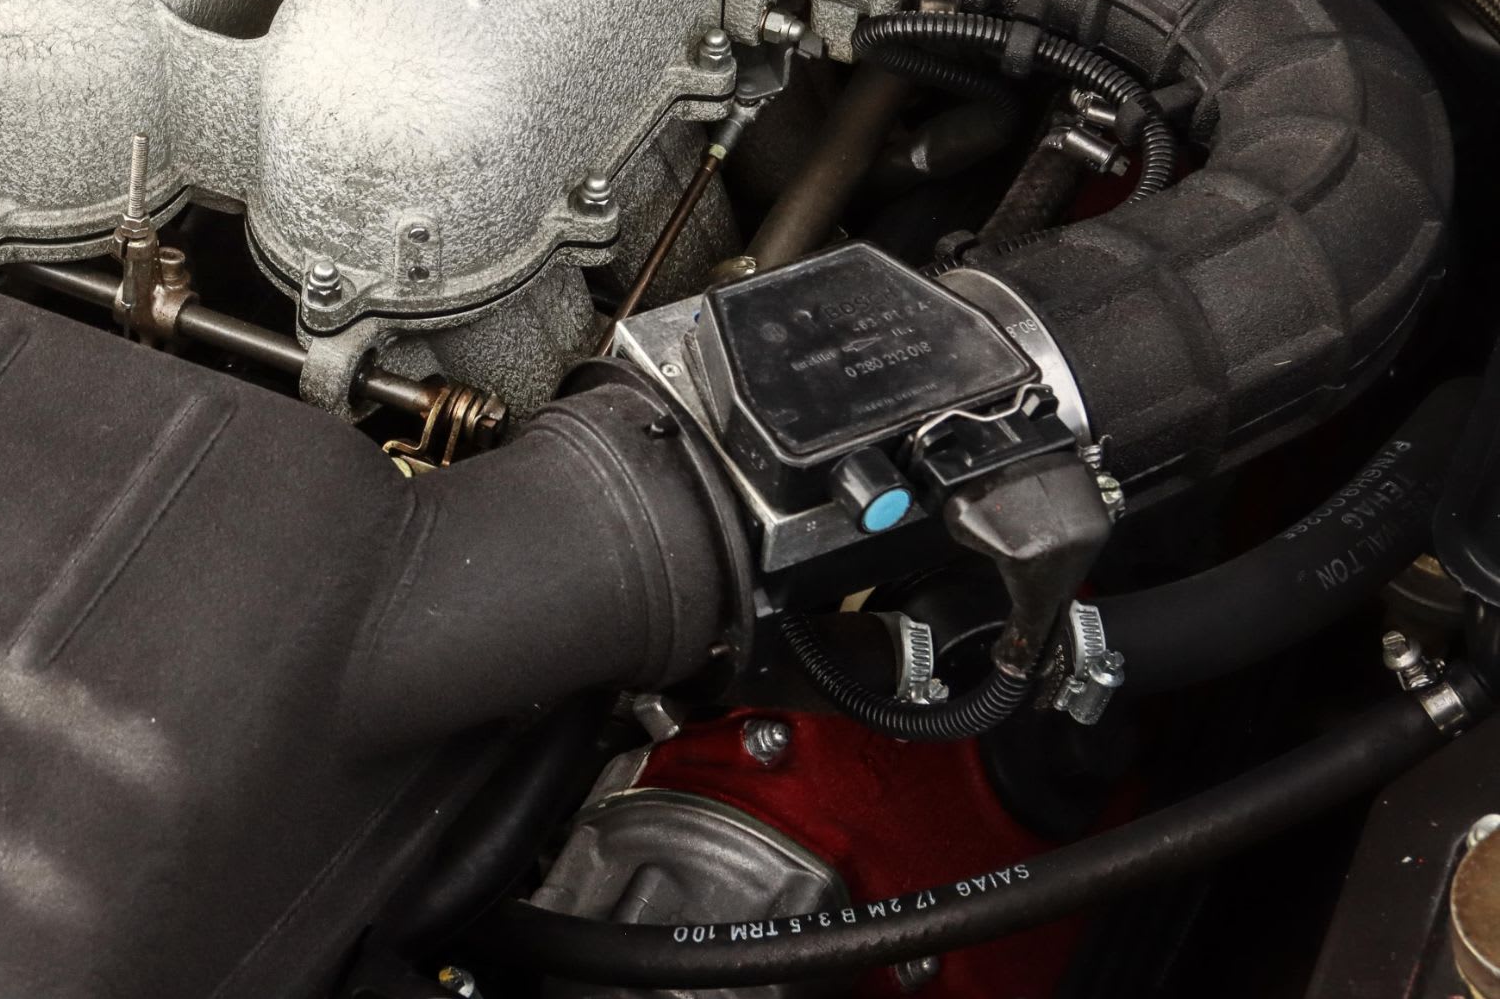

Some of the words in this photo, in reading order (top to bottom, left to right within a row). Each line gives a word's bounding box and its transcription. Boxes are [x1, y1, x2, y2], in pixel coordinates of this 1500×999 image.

[844, 365, 857, 378] 0
[856, 356, 884, 375] 280
[883, 348, 909, 366] 212
[906, 340, 932, 358] 018
[955, 863, 1031, 897] SAIAG
[915, 890, 937, 910] 17
[841, 907, 857, 924] B
[672, 925, 717, 943] 100
[729, 920, 779, 942] TRM
